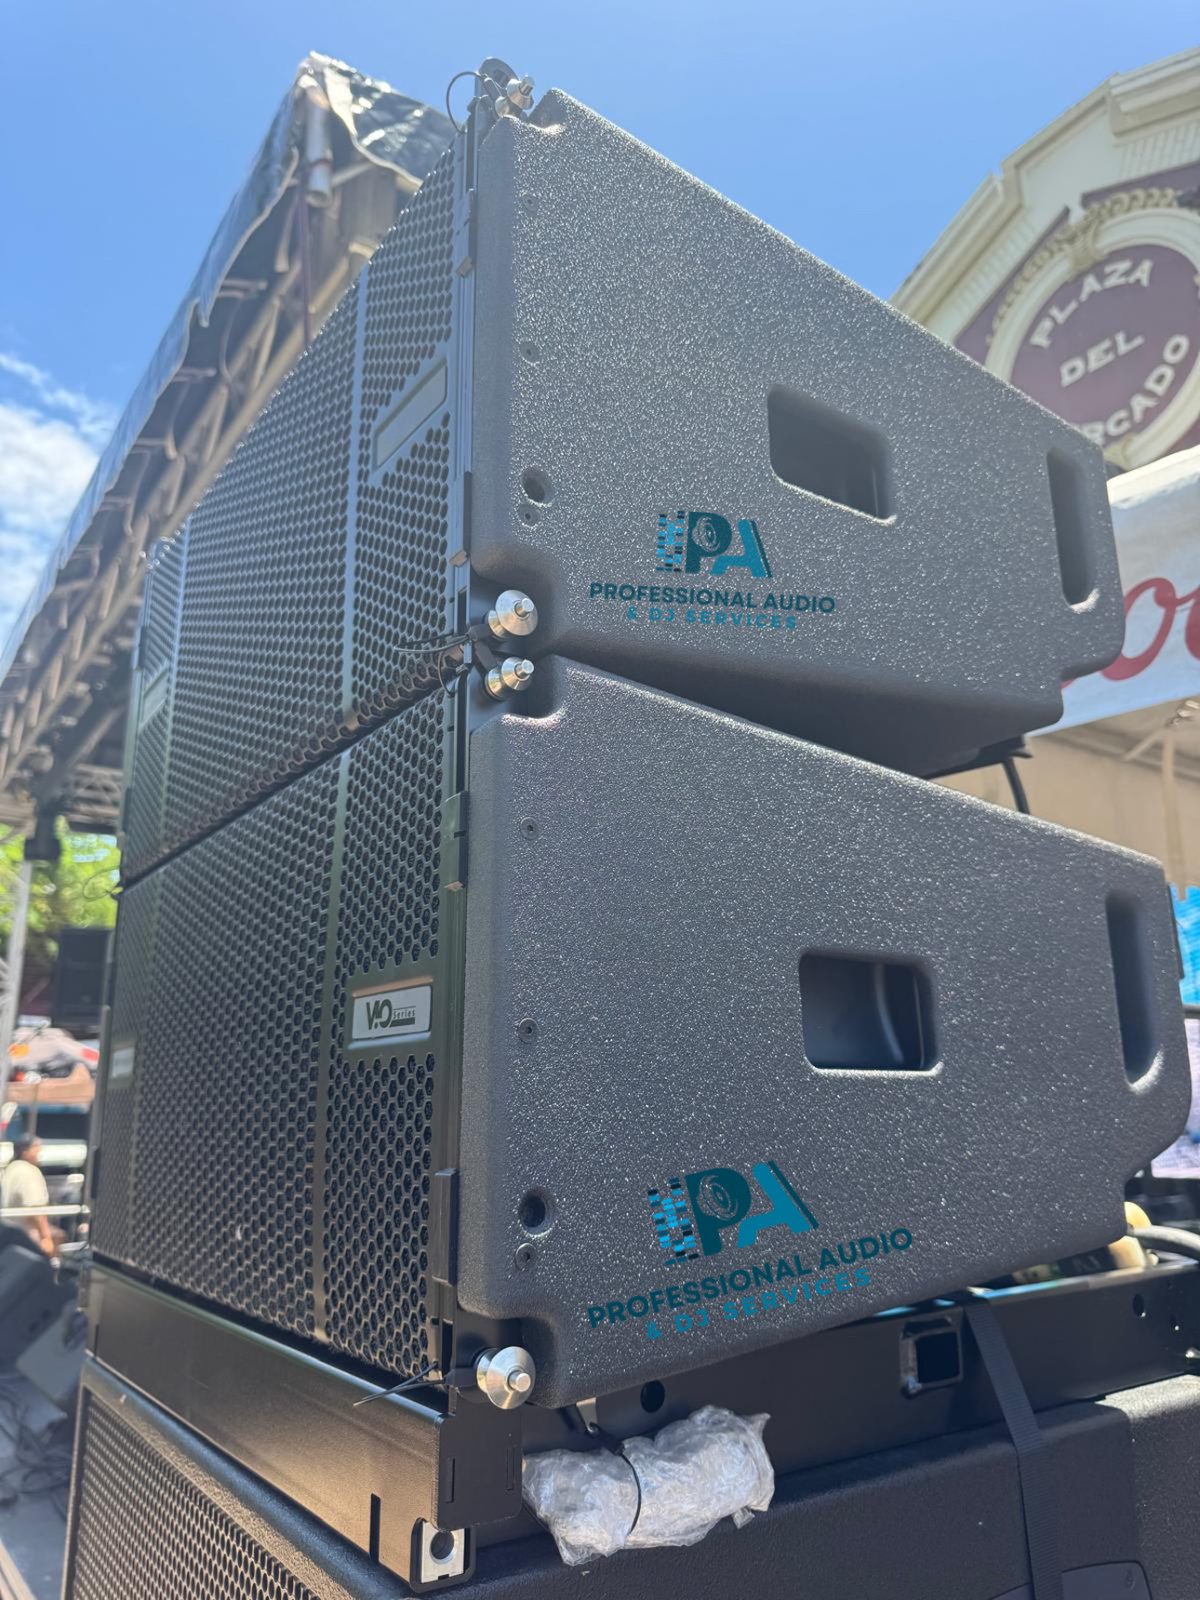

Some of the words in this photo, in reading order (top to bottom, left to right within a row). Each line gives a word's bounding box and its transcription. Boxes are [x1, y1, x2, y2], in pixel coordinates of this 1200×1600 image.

[1029, 258, 1153, 349] PLAZA
[1058, 329, 1146, 388] DEL
[589, 582, 758, 609] PROFESSIONAL
[763, 592, 836, 613] AUDIO
[627, 606, 638, 621] &
[649, 607, 676, 622] DJ
[685, 609, 797, 630] SERVICES
[587, 1254, 812, 1328] PROFESSIONAL
[818, 1228, 913, 1270] AUDIO
[646, 1322, 661, 1340] &
[674, 1309, 710, 1333] DJ
[723, 1267, 872, 1320] SERVICES
